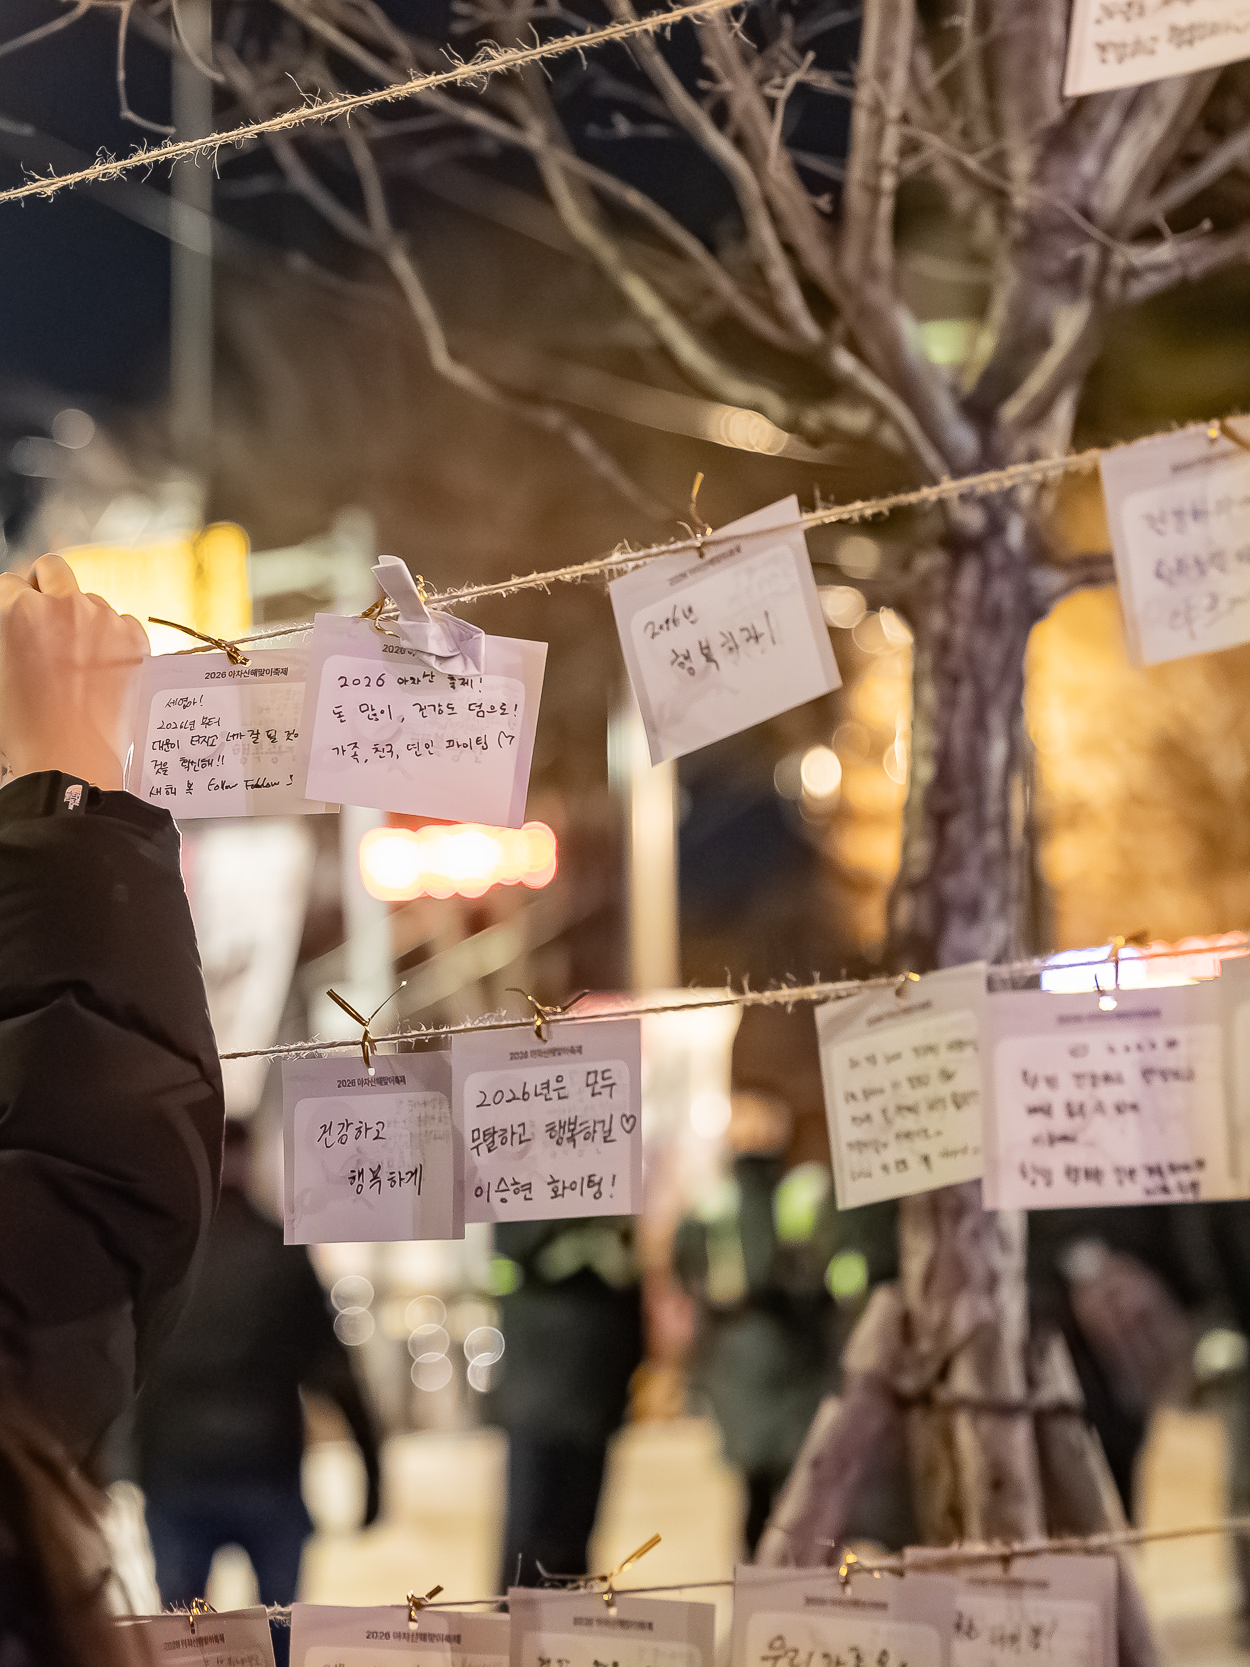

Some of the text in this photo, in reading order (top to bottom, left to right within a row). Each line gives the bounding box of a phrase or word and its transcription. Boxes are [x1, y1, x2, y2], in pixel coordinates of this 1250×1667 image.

[205, 670, 227, 680] 2026
[337, 673, 386, 689] 2026
[156, 716, 221, 731] 2026년 부터
[332, 702, 519, 724] 돈 많이, 건강도 덤으로!
[331, 734, 489, 764] 가족, 친구, 연인 파이팅
[336, 1078, 356, 1088] 2026
[475, 1068, 617, 1109] 2026년은 모두
[317, 1118, 387, 1149] 건강하고
[470, 1113, 617, 1157] 무탈하고 행복하길
[347, 1163, 423, 1196] 행복하게
[474, 1176, 533, 1204] 이승현
